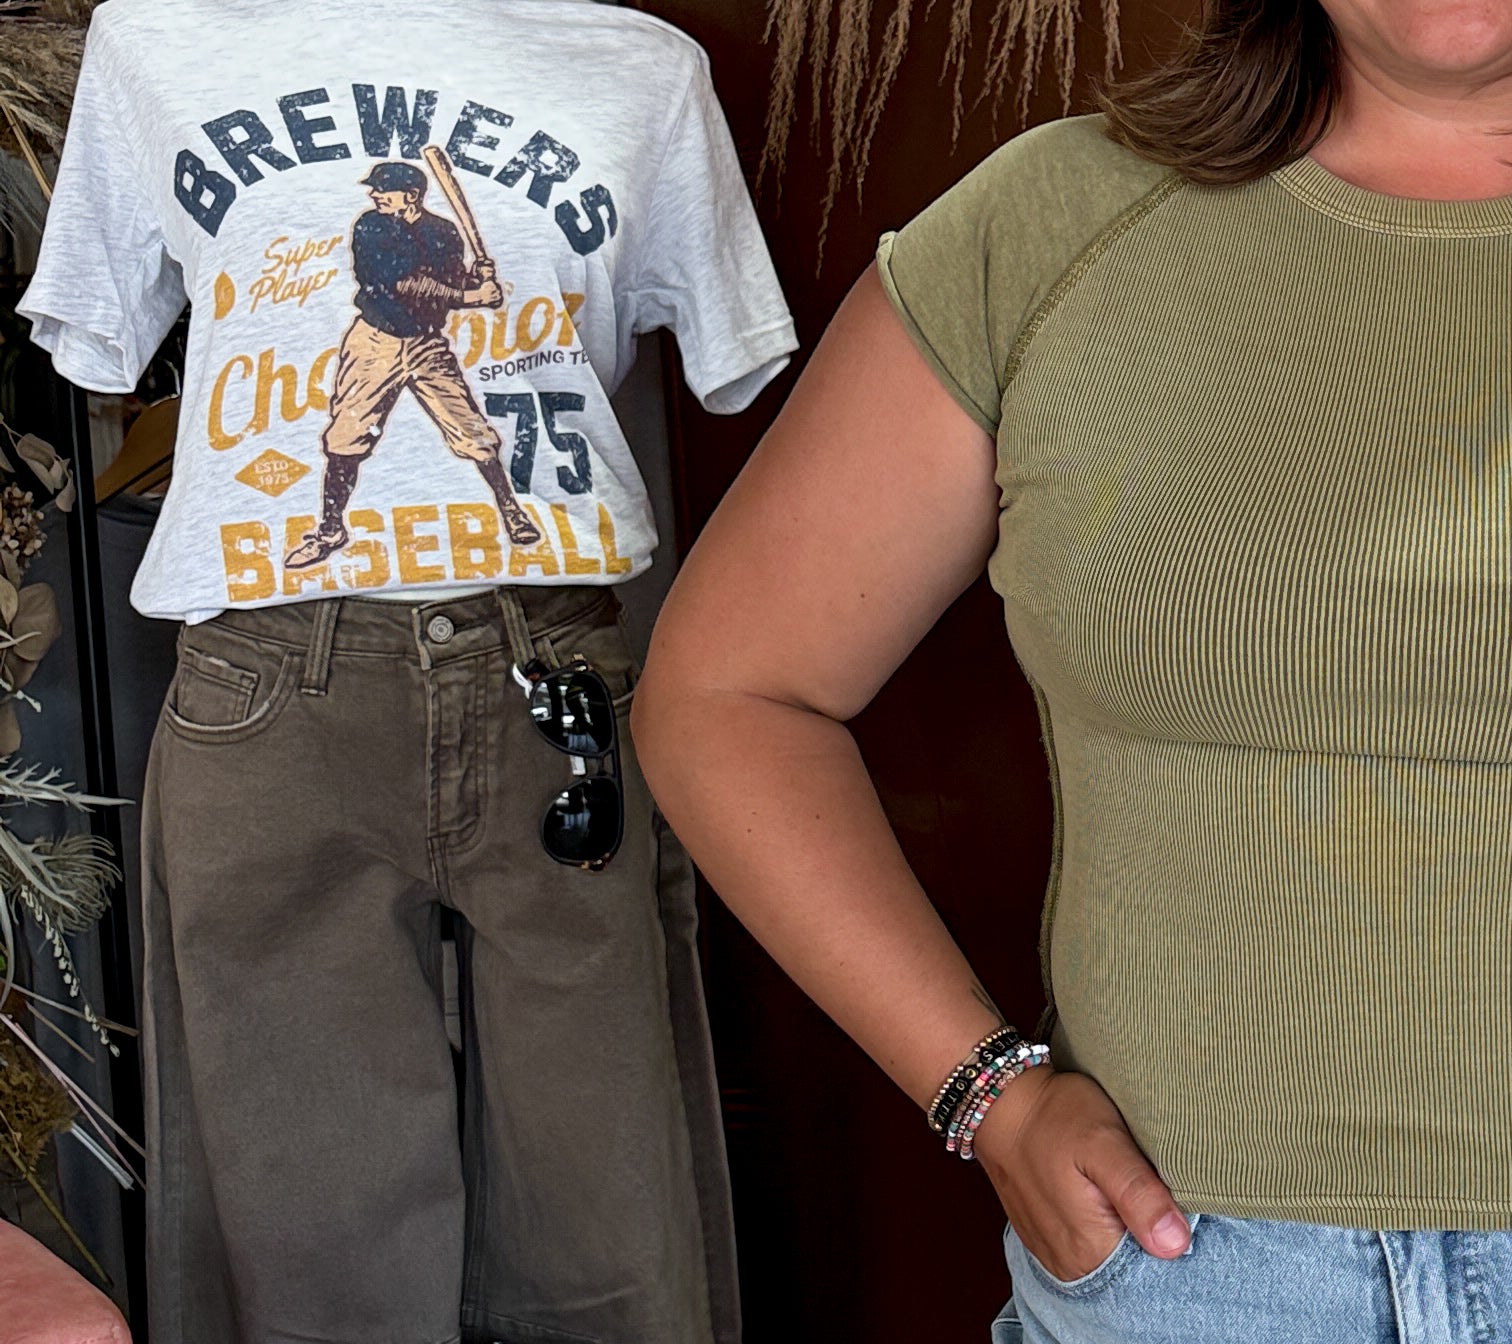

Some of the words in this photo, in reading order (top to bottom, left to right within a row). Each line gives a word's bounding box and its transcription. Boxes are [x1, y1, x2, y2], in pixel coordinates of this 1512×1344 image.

[173, 83, 618, 256] BREWERS
[250, 268, 338, 313] Player
[262, 235, 343, 277] Super
[479, 349, 565, 382] SPORTING
[483, 391, 592, 495] 75
[220, 502, 633, 602] BASEBALL
